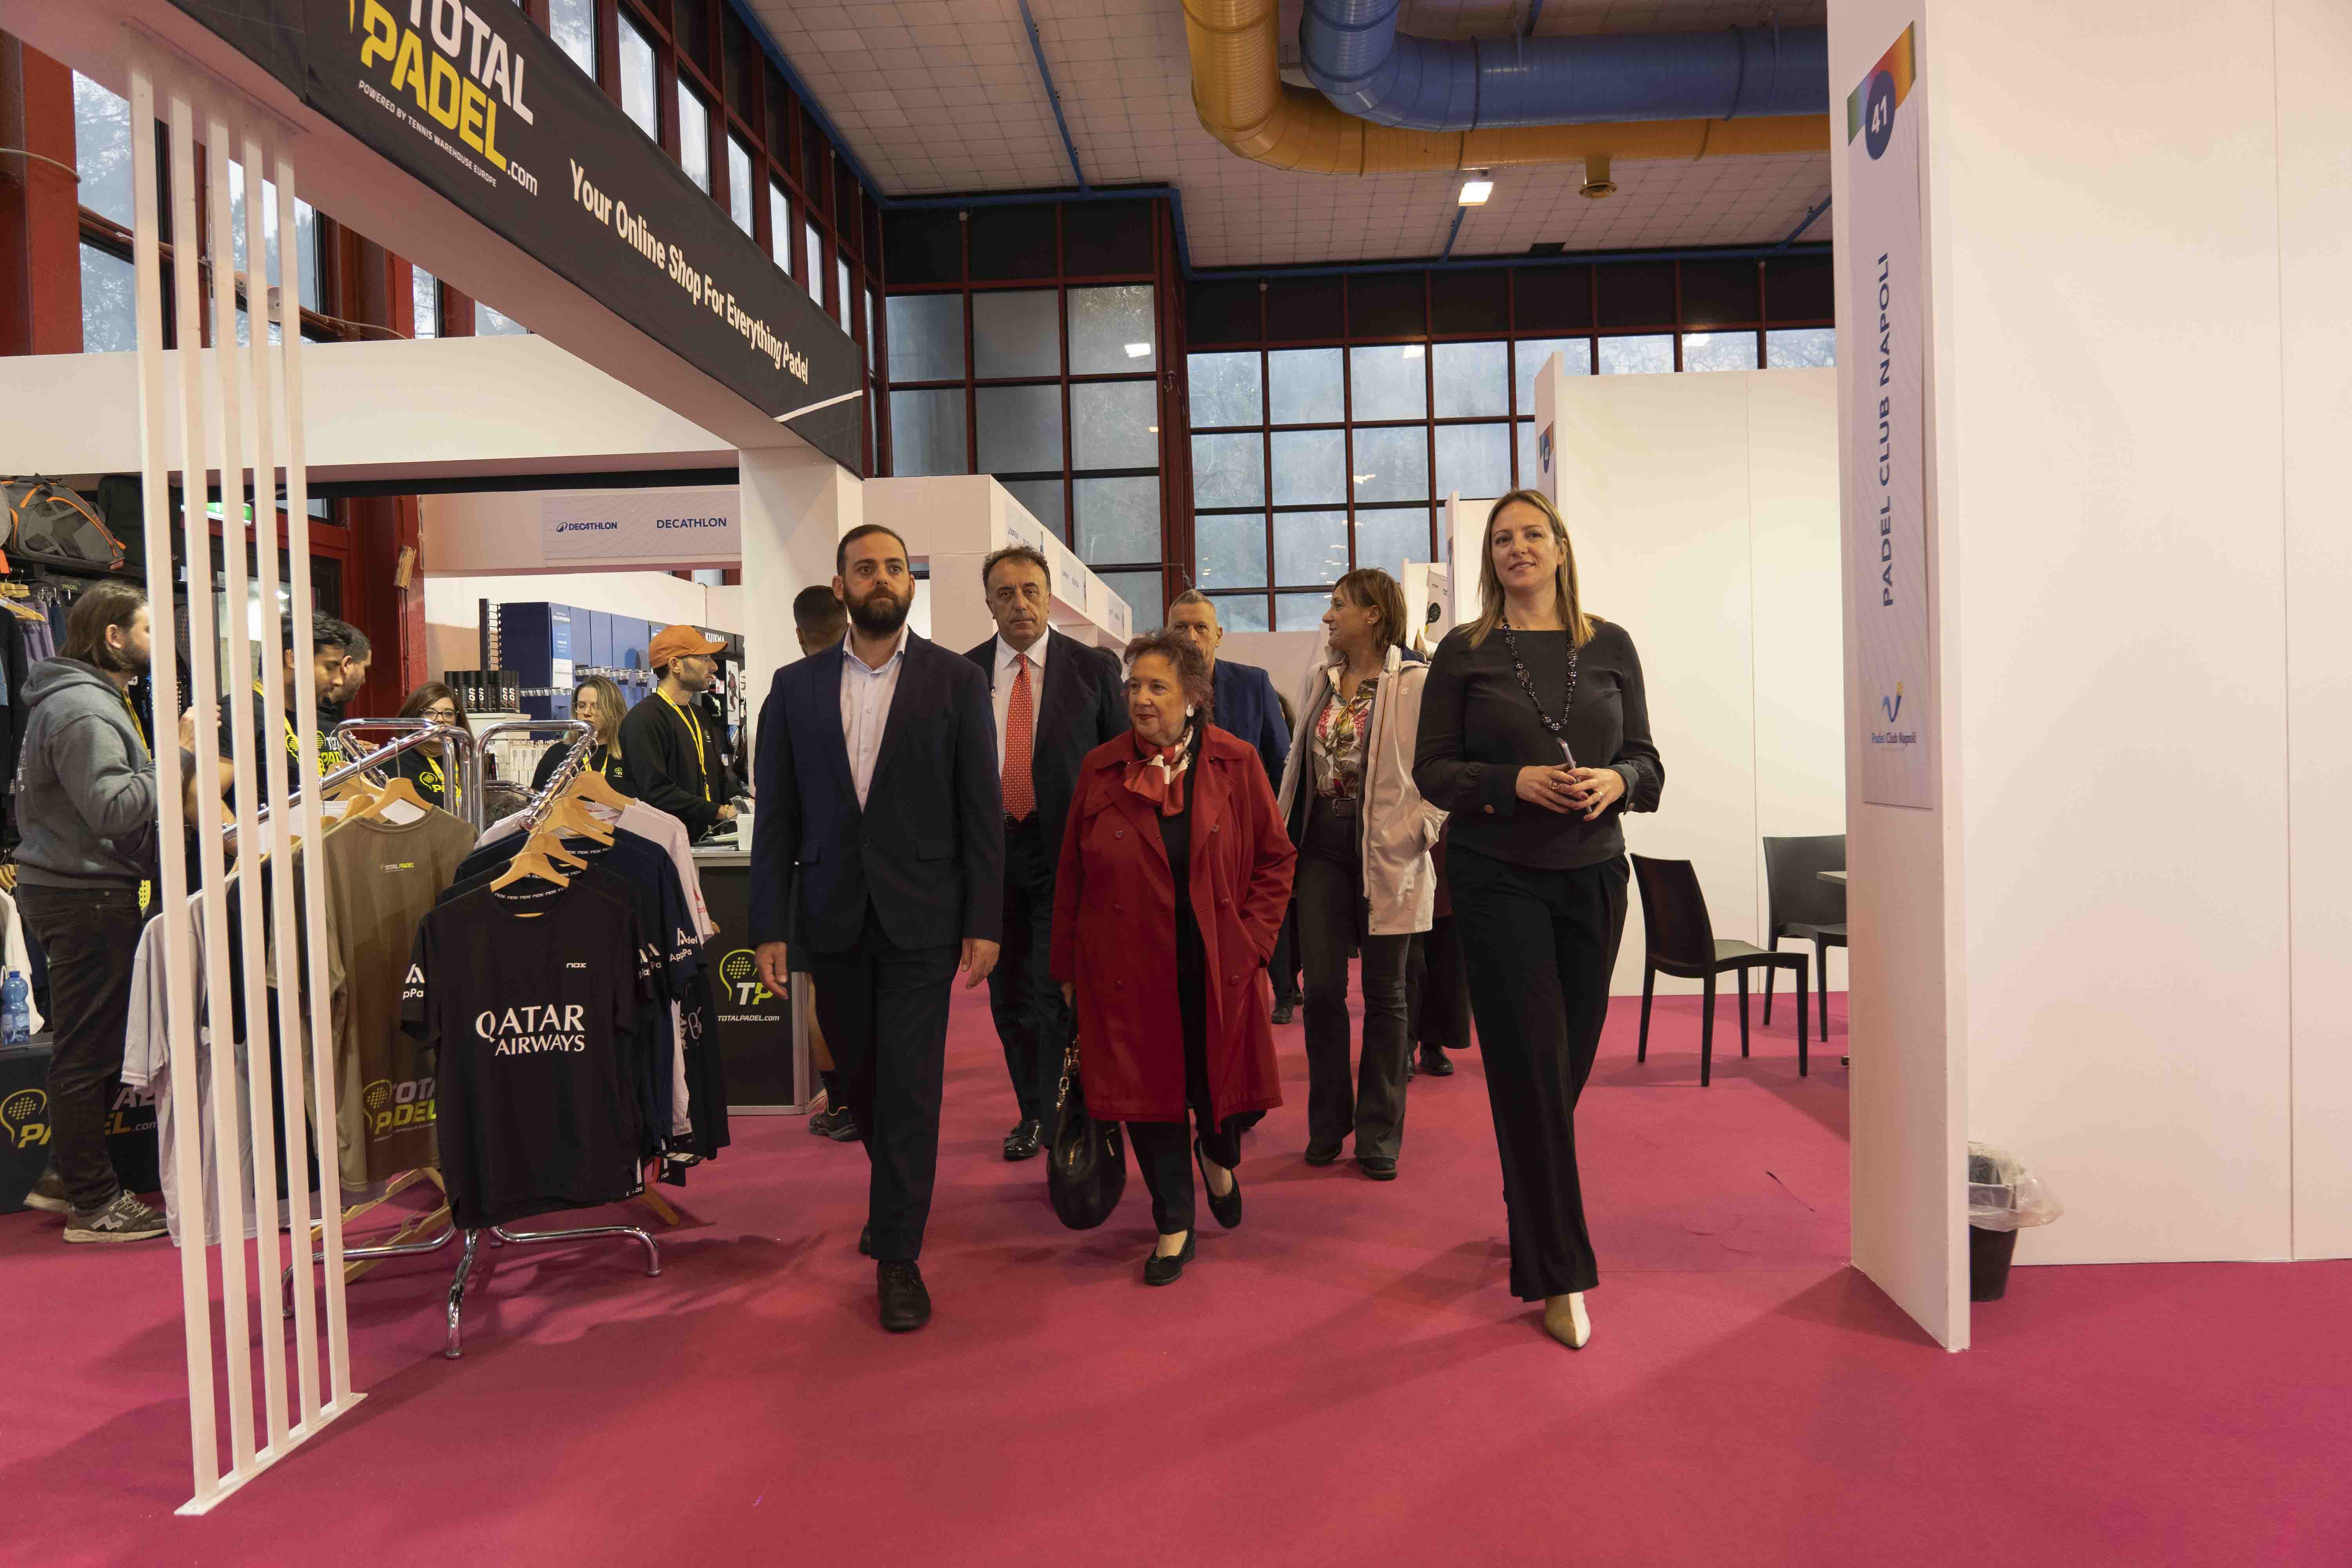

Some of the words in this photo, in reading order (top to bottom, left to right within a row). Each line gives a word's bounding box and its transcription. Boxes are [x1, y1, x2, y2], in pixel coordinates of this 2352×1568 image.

[358, 80, 396, 114] POWERED
[396, 107, 407, 121] BY
[408, 116, 433, 140] TENNIS
[434, 135, 473, 170] WAREHOUSE
[474, 162, 497, 188] EUROPE
[1871, 94, 1887, 134] 41
[570, 157, 612, 226] Your
[616, 200, 666, 270] Online
[668, 244, 701, 306] Shop
[704, 274, 724, 317] For
[727, 292, 782, 370] Everything
[783, 340, 808, 385] Padel
[1878, 252, 1890, 387] NAPOLI
[1879, 395, 1890, 486] CLUB
[568, 522, 617, 531] DECATHLON
[656, 518, 727, 529] DECATHLON
[1880, 495, 1894, 608] PADEL
[705, 632, 725, 643] KUIKMA
[475, 1004, 585, 1044] QATAR
[495, 1034, 585, 1056] AIRWAYS
